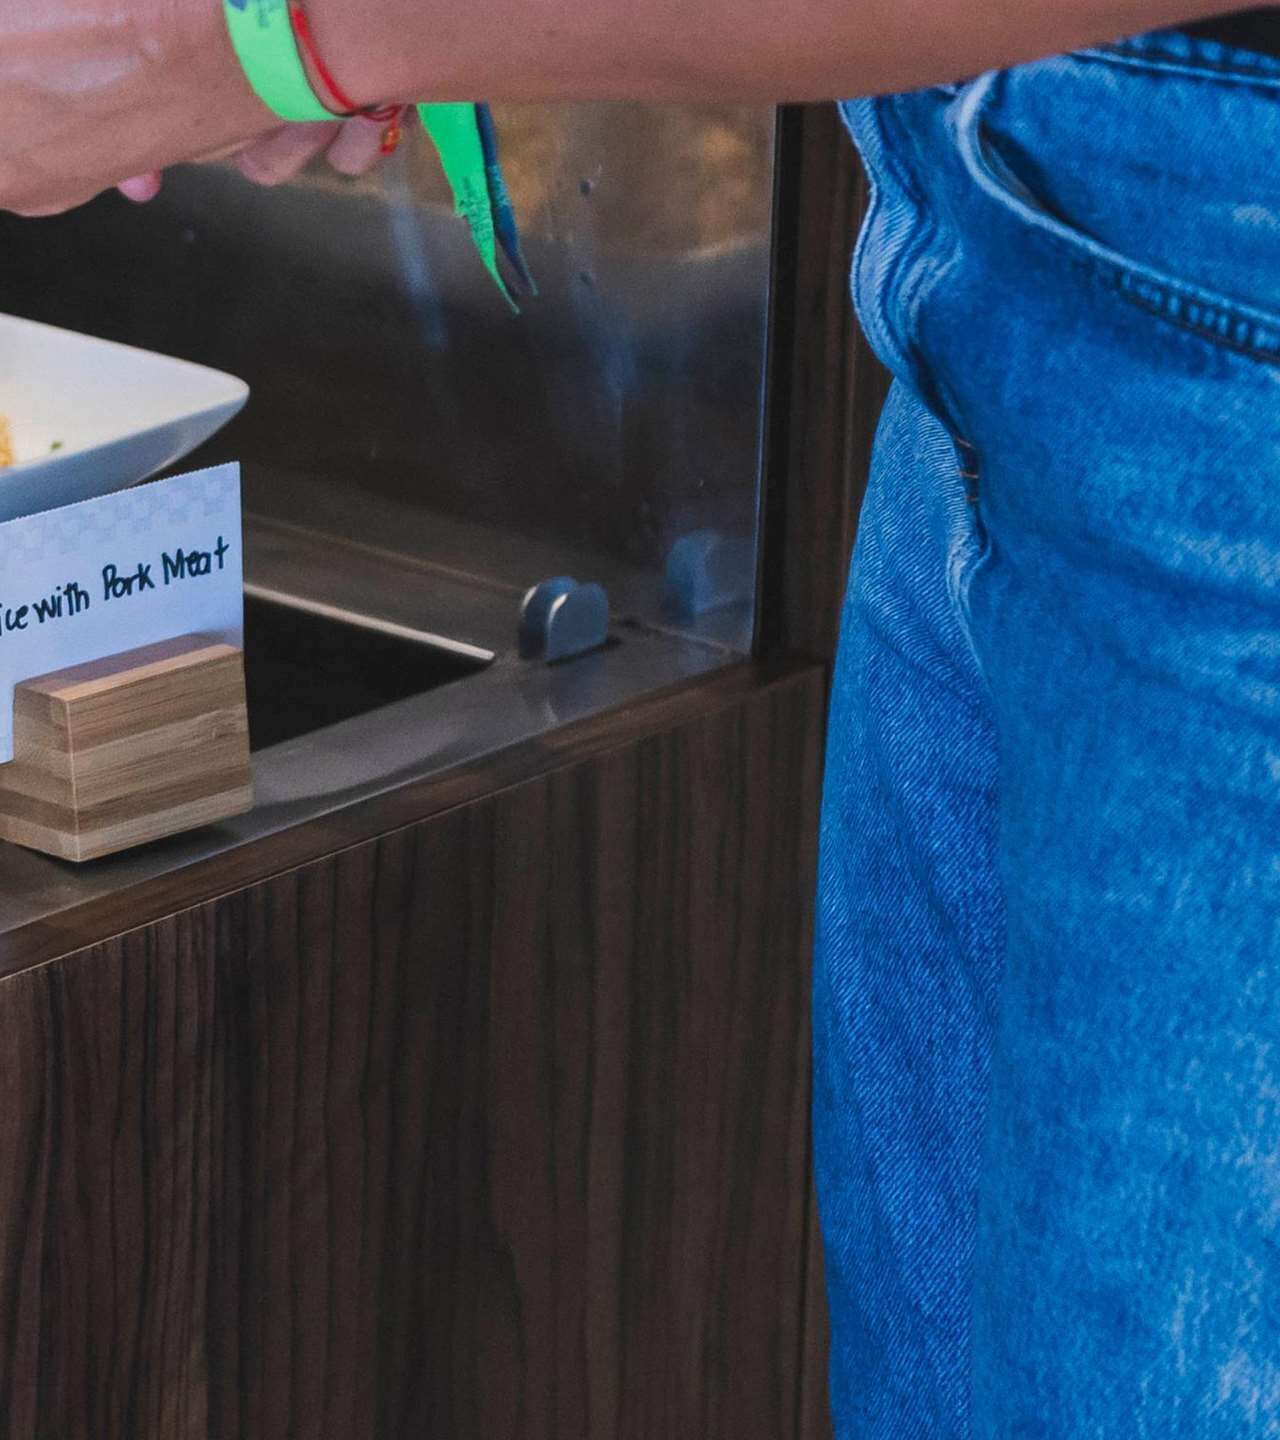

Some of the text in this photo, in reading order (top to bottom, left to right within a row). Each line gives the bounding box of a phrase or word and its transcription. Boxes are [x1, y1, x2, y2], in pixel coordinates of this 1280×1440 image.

[32, 582, 90, 623] with
[102, 563, 155, 601] Pork
[161, 535, 230, 585] Meat
